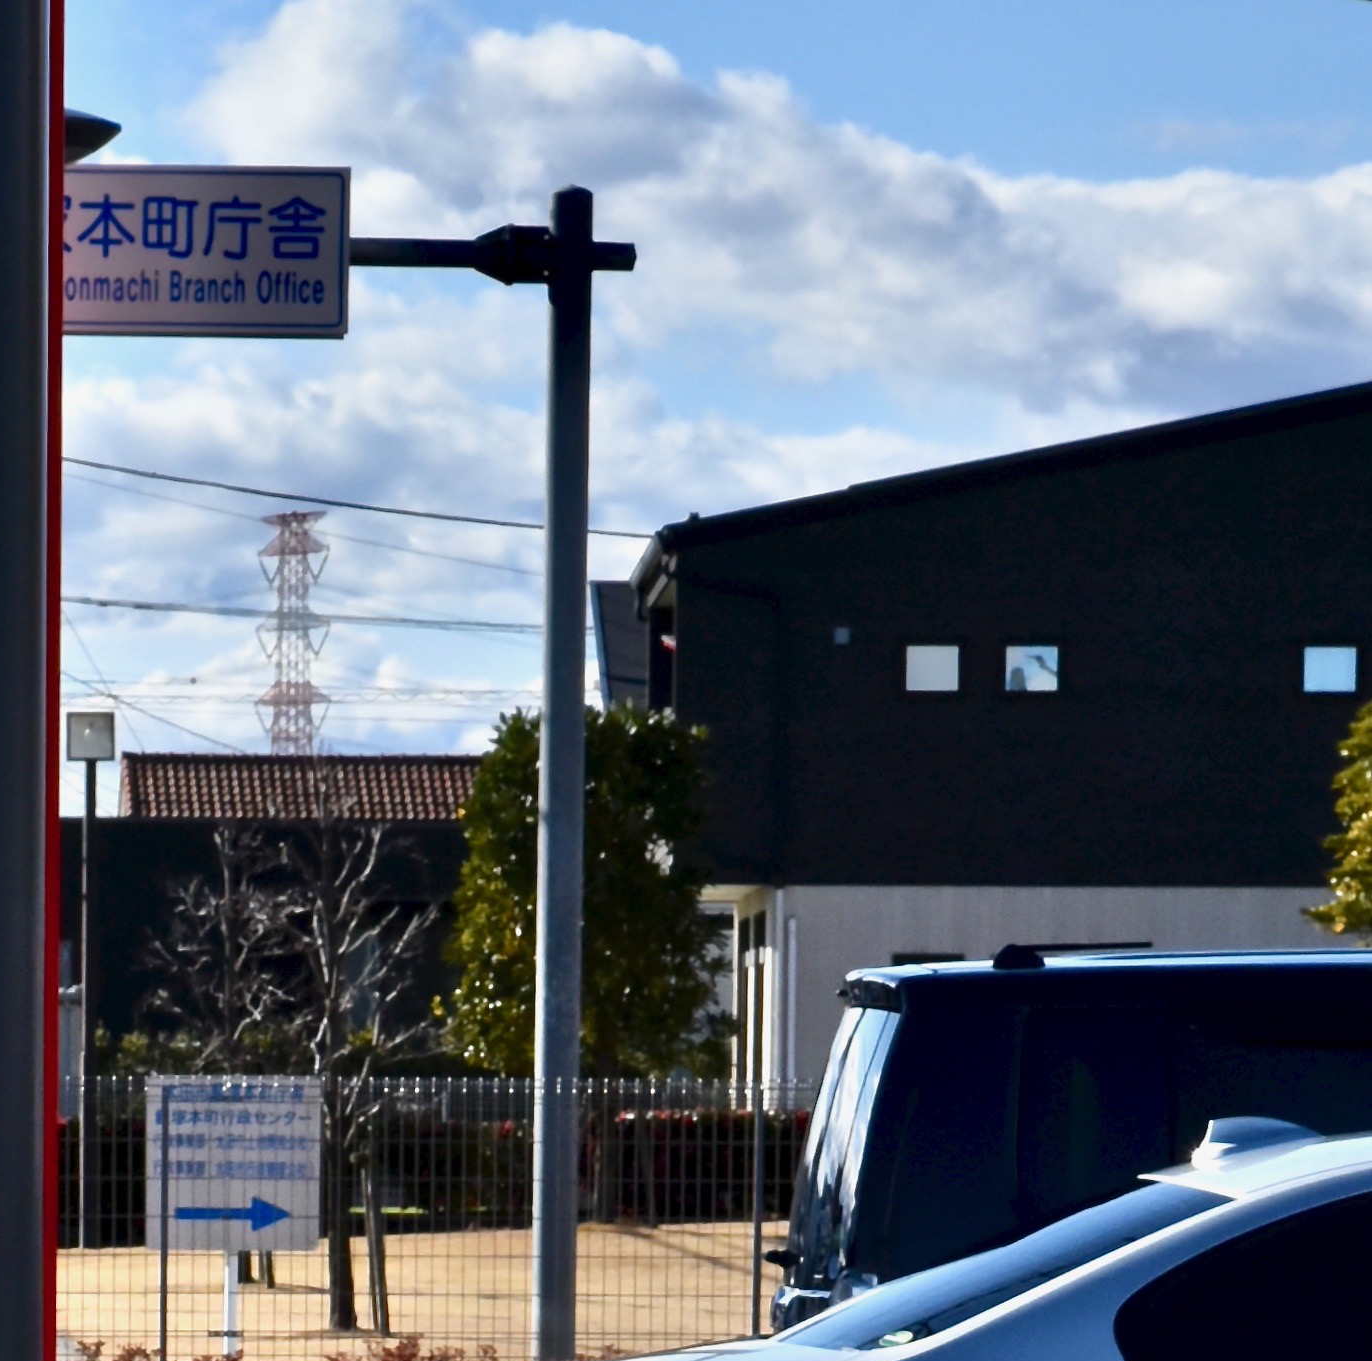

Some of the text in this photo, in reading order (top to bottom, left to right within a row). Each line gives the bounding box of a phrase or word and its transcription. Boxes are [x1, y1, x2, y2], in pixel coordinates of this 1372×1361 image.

[63, 194, 326, 260] 本町庁舎
[169, 270, 246, 303] Branch
[256, 270, 325, 304] Office
